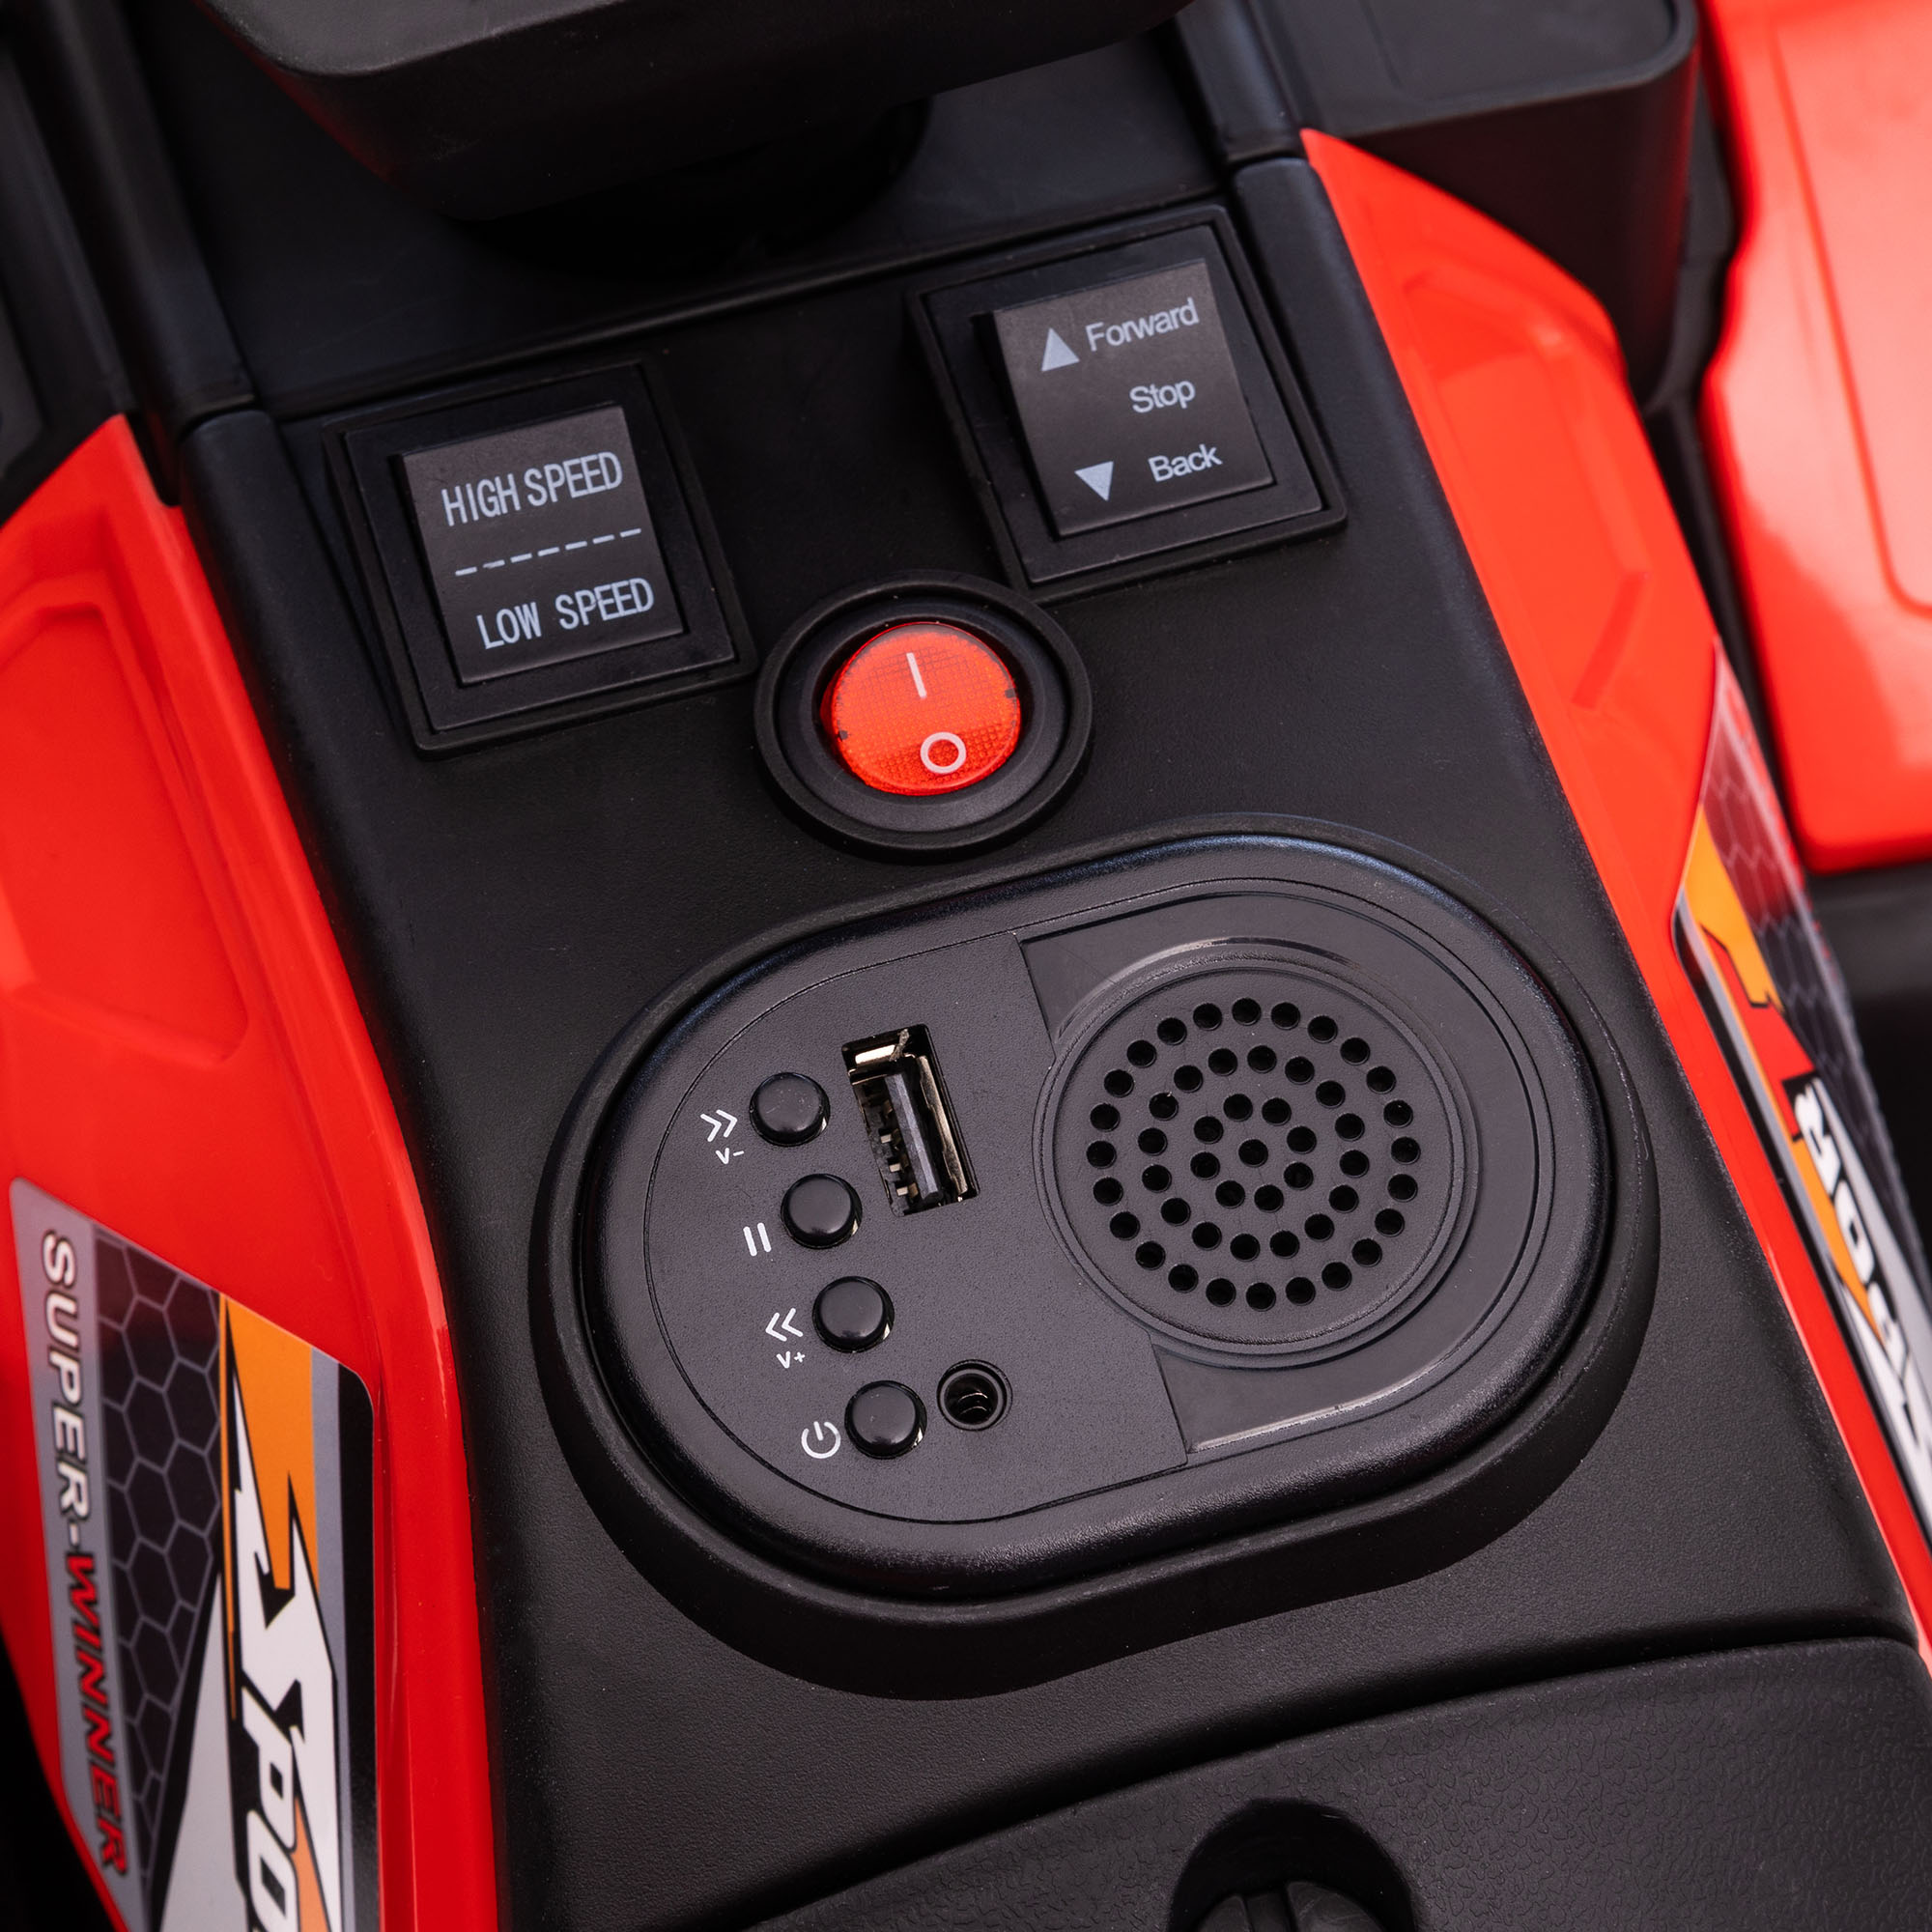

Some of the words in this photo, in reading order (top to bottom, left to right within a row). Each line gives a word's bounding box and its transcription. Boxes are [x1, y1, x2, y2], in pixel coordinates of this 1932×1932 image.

[1085, 296, 1201, 353] Forward
[1129, 379, 1197, 414] Stop
[440, 471, 523, 527] HIGH
[523, 451, 624, 508] SPEED
[1148, 443, 1223, 483] Back
[476, 600, 543, 650] LOW
[554, 577, 655, 631] SPEED
[42, 1230, 128, 1875] SUPER-WINNER
[232, 1370, 339, 1932] SPO
